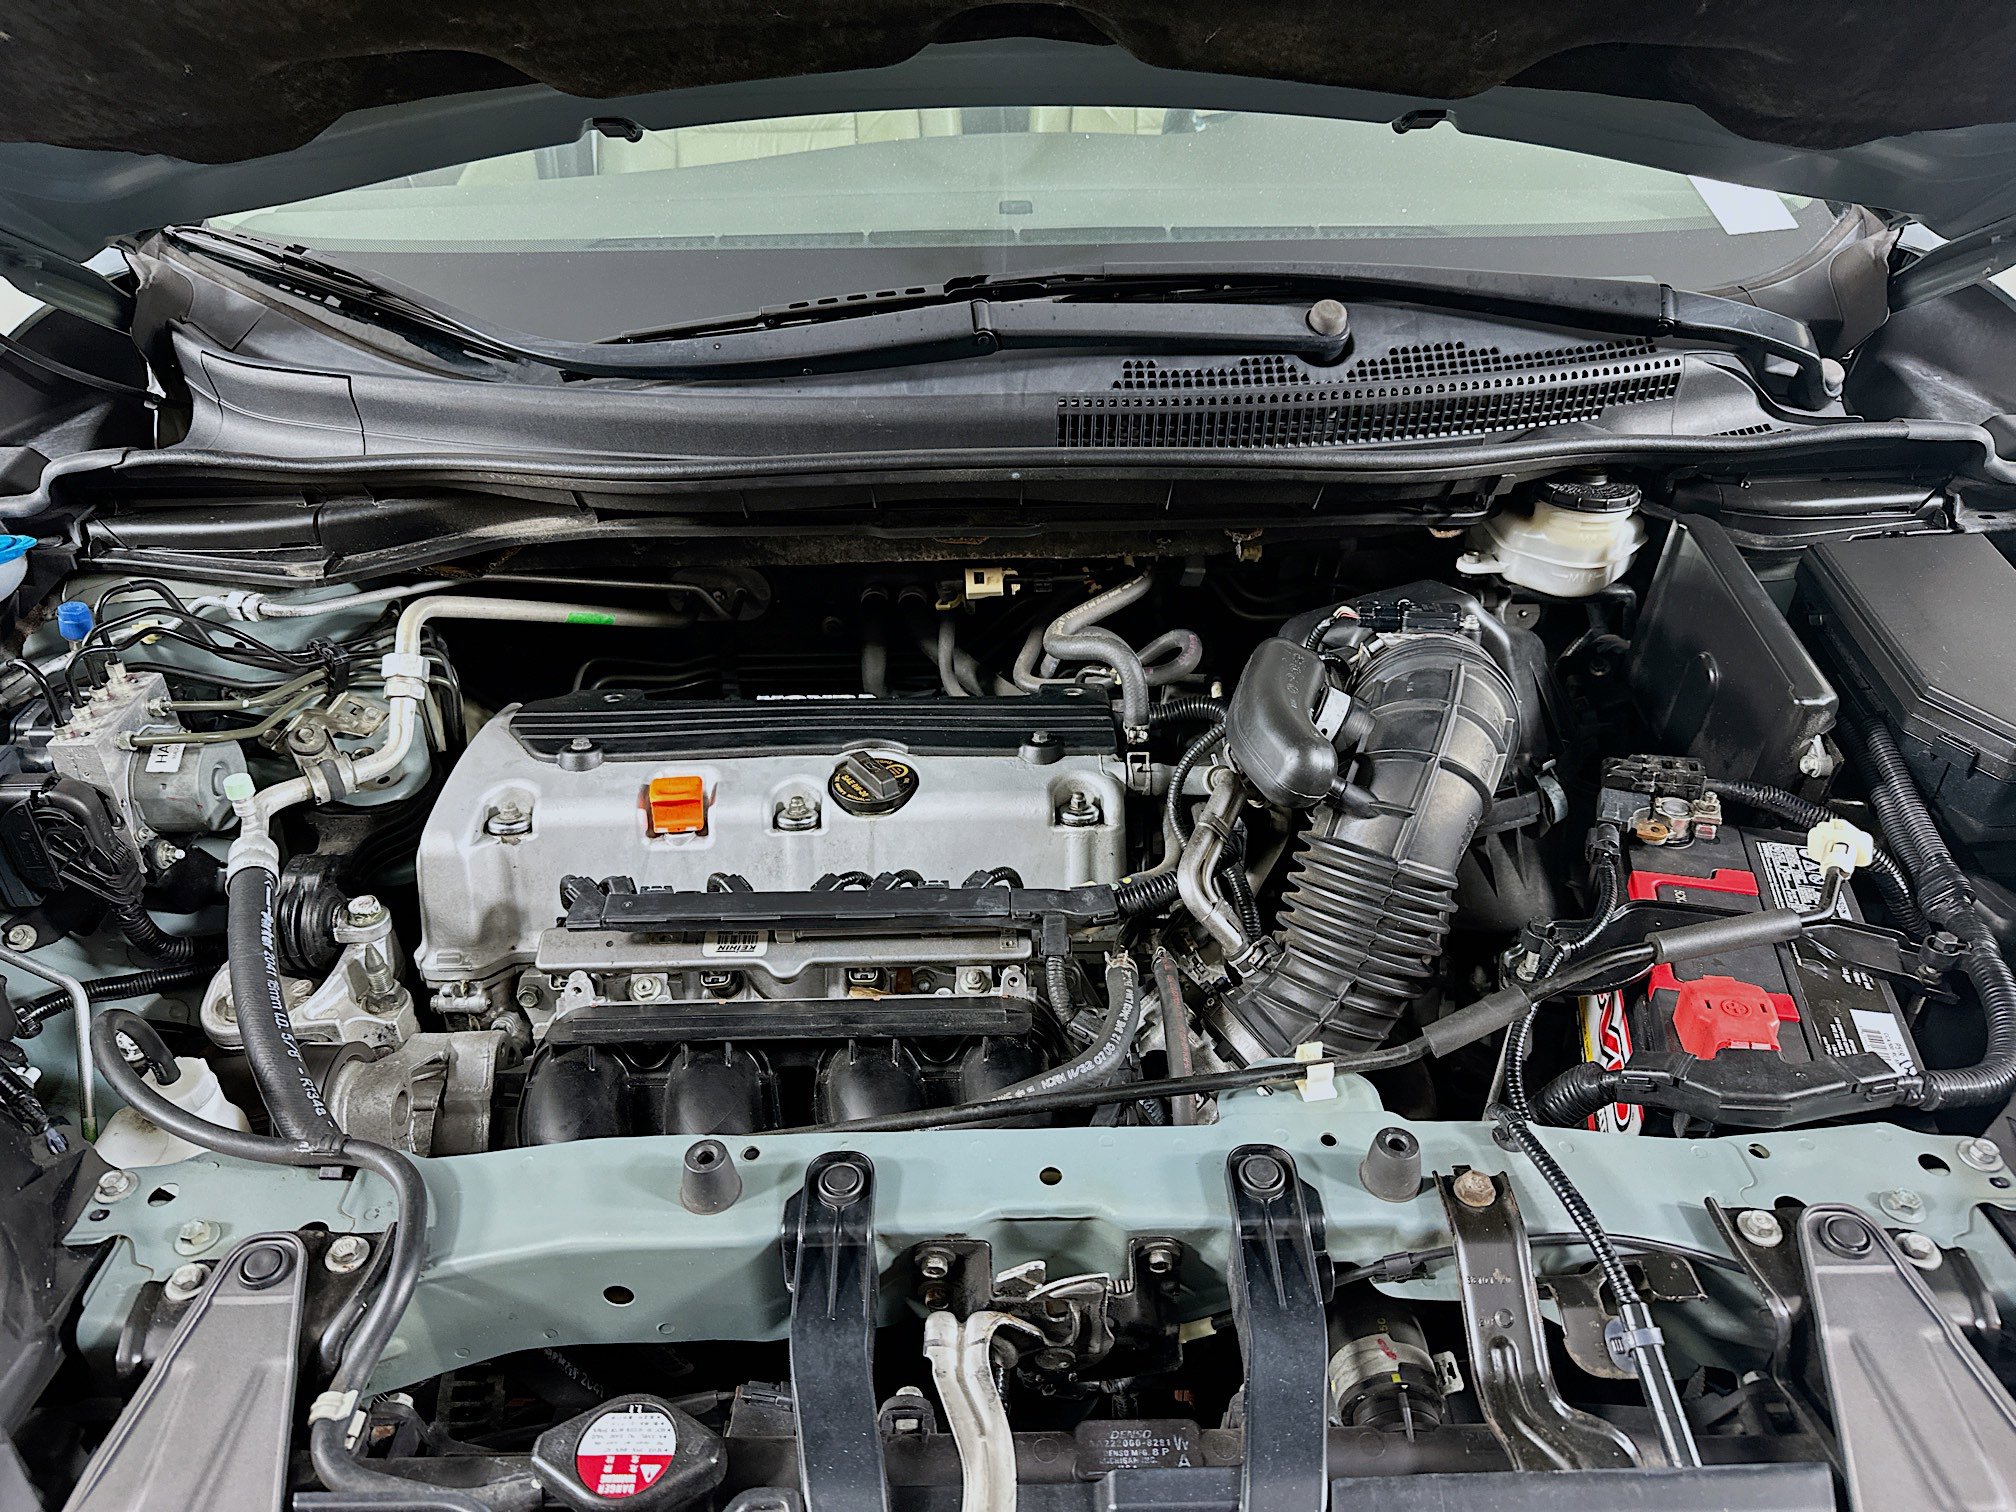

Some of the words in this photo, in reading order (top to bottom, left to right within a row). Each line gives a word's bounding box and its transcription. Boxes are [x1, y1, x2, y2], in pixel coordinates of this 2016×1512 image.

[155, 745, 170, 763] HA
[260, 911, 273, 949] Parker
[265, 950, 276, 975] 2041
[1110, 1430, 1152, 1439] DENSO
[1178, 1454, 1191, 1467] A
